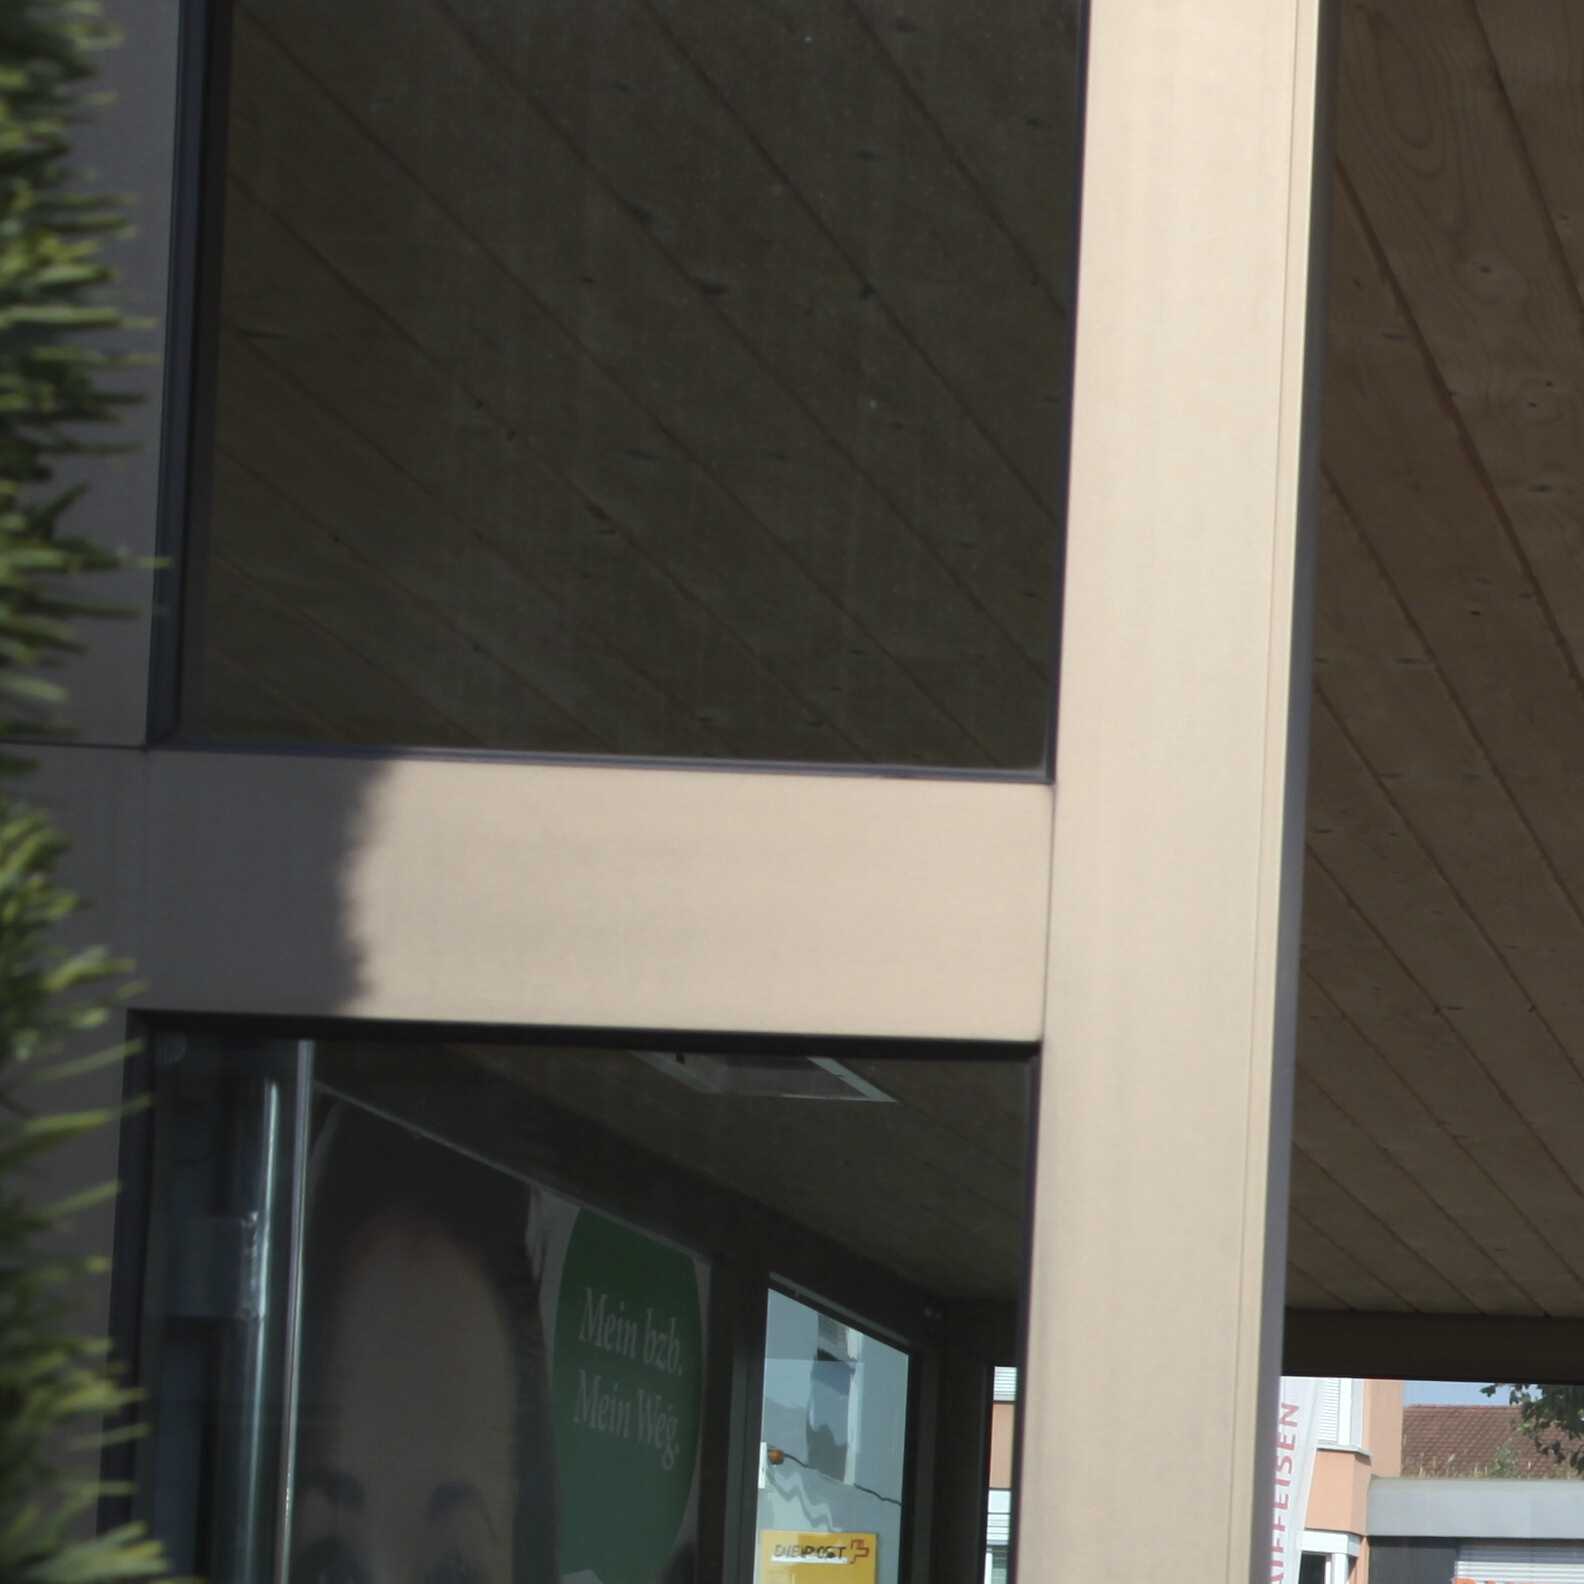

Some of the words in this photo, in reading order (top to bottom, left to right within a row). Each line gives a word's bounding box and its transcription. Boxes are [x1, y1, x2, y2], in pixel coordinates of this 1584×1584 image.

[579, 1287, 638, 1359] Mein
[573, 1369, 631, 1438] Mein
[637, 1388, 681, 1471] Weg.
